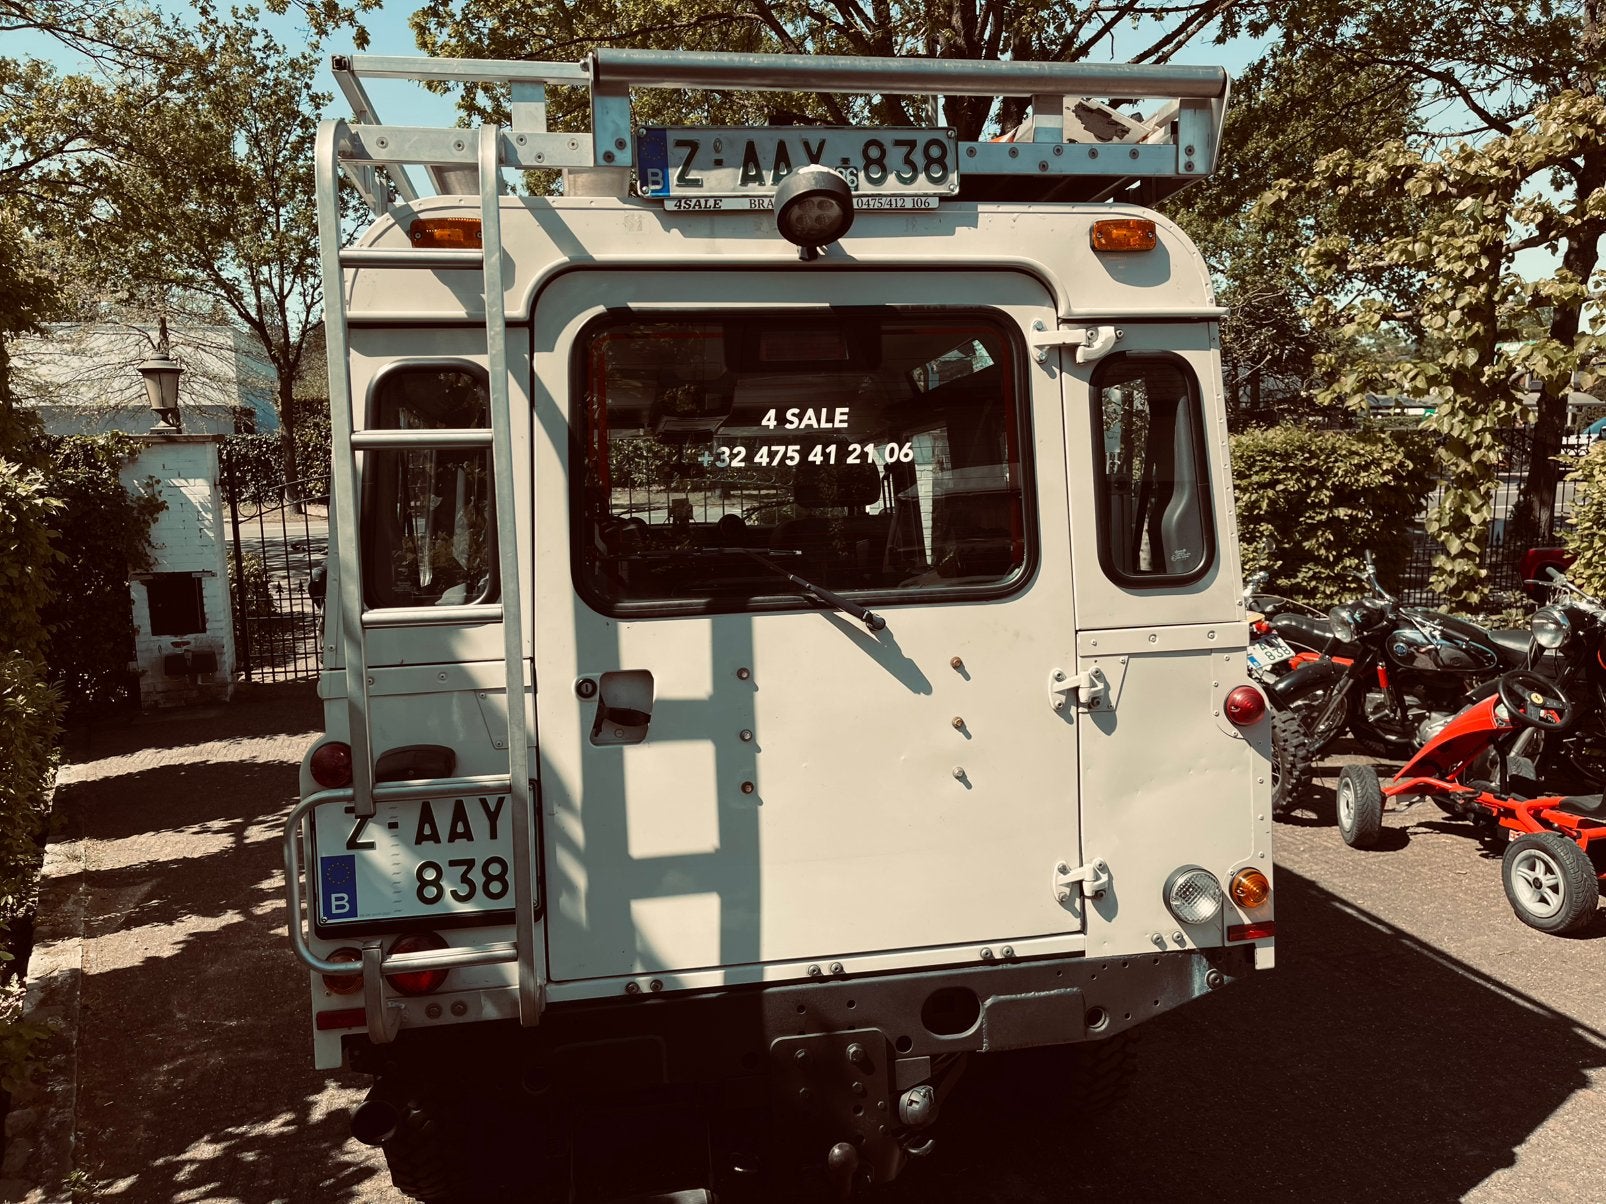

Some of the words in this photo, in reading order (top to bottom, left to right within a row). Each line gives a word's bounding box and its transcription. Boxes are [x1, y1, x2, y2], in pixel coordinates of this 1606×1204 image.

[648, 168, 664, 190] B
[674, 198, 723, 210] 4SALE
[856, 197, 906, 209] 0475/412
[912, 197, 930, 208] 106
[761, 408, 778, 430] 4
[784, 407, 850, 430] SALE
[697, 446, 746, 468] +32
[753, 445, 800, 467] 475
[808, 444, 837, 465] 41
[846, 443, 875, 464] 21
[884, 442, 914, 463] 06
[415, 856, 510, 906] 838
[330, 893, 351, 914] B
